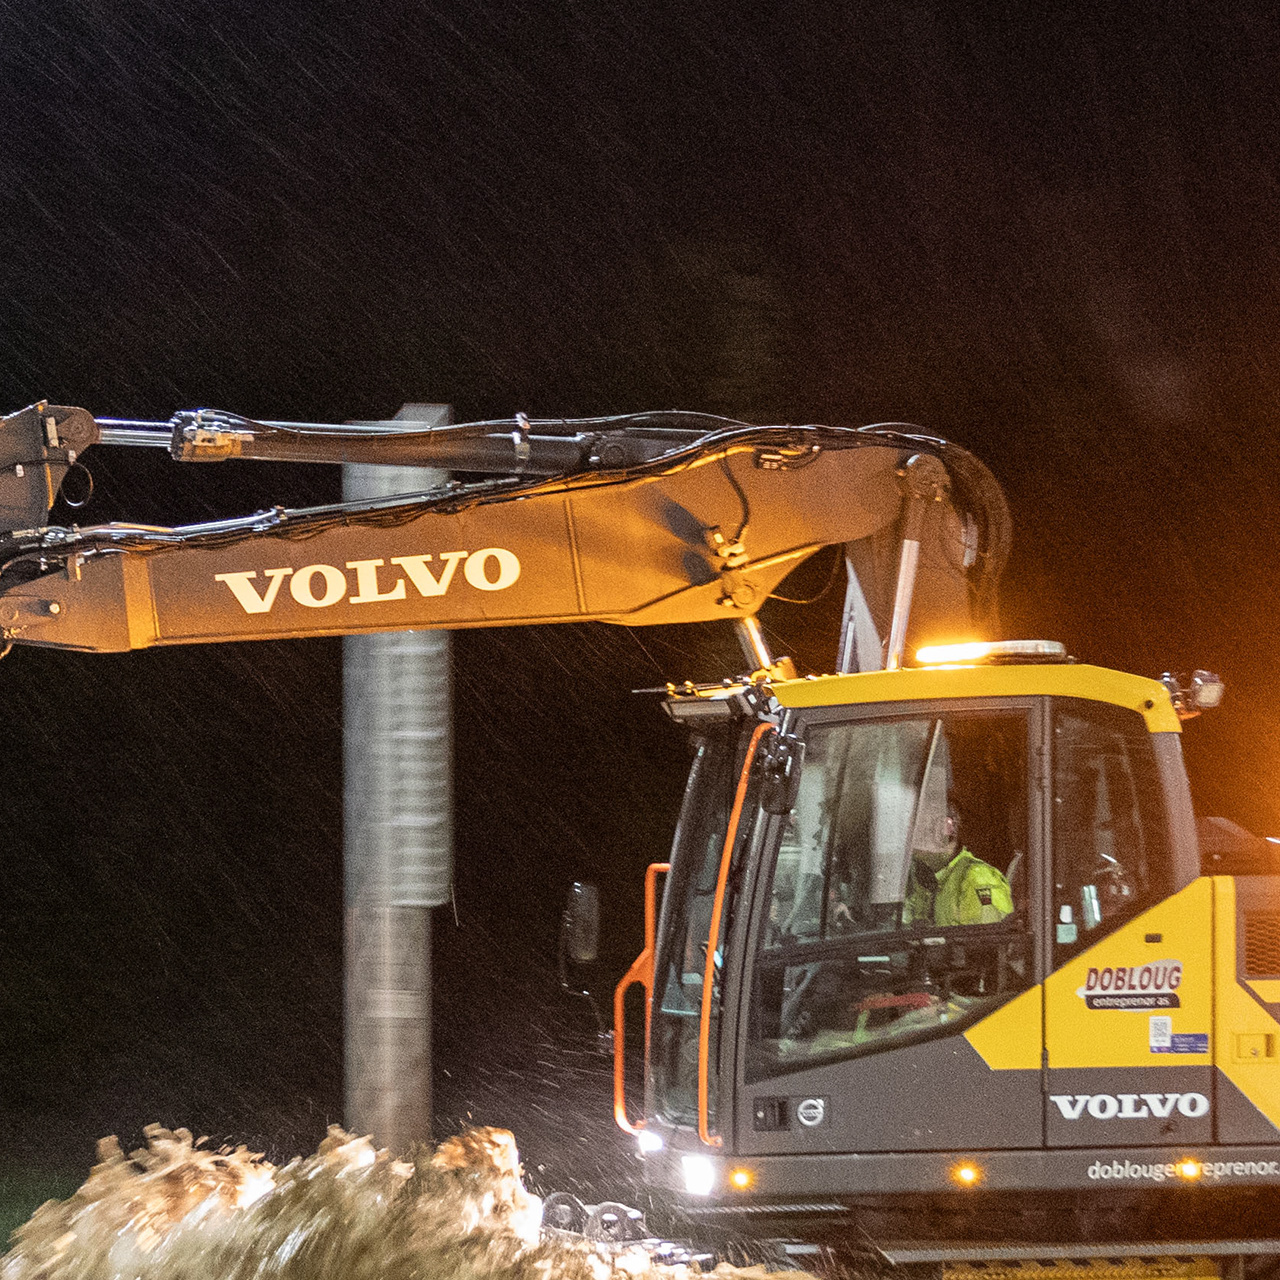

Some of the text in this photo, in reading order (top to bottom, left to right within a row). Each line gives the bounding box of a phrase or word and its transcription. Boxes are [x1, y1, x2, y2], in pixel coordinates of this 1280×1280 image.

[214, 547, 521, 614] VOLVO
[1086, 966, 1181, 991] DOBLOUG
[1049, 1092, 1210, 1120] VOLVO
